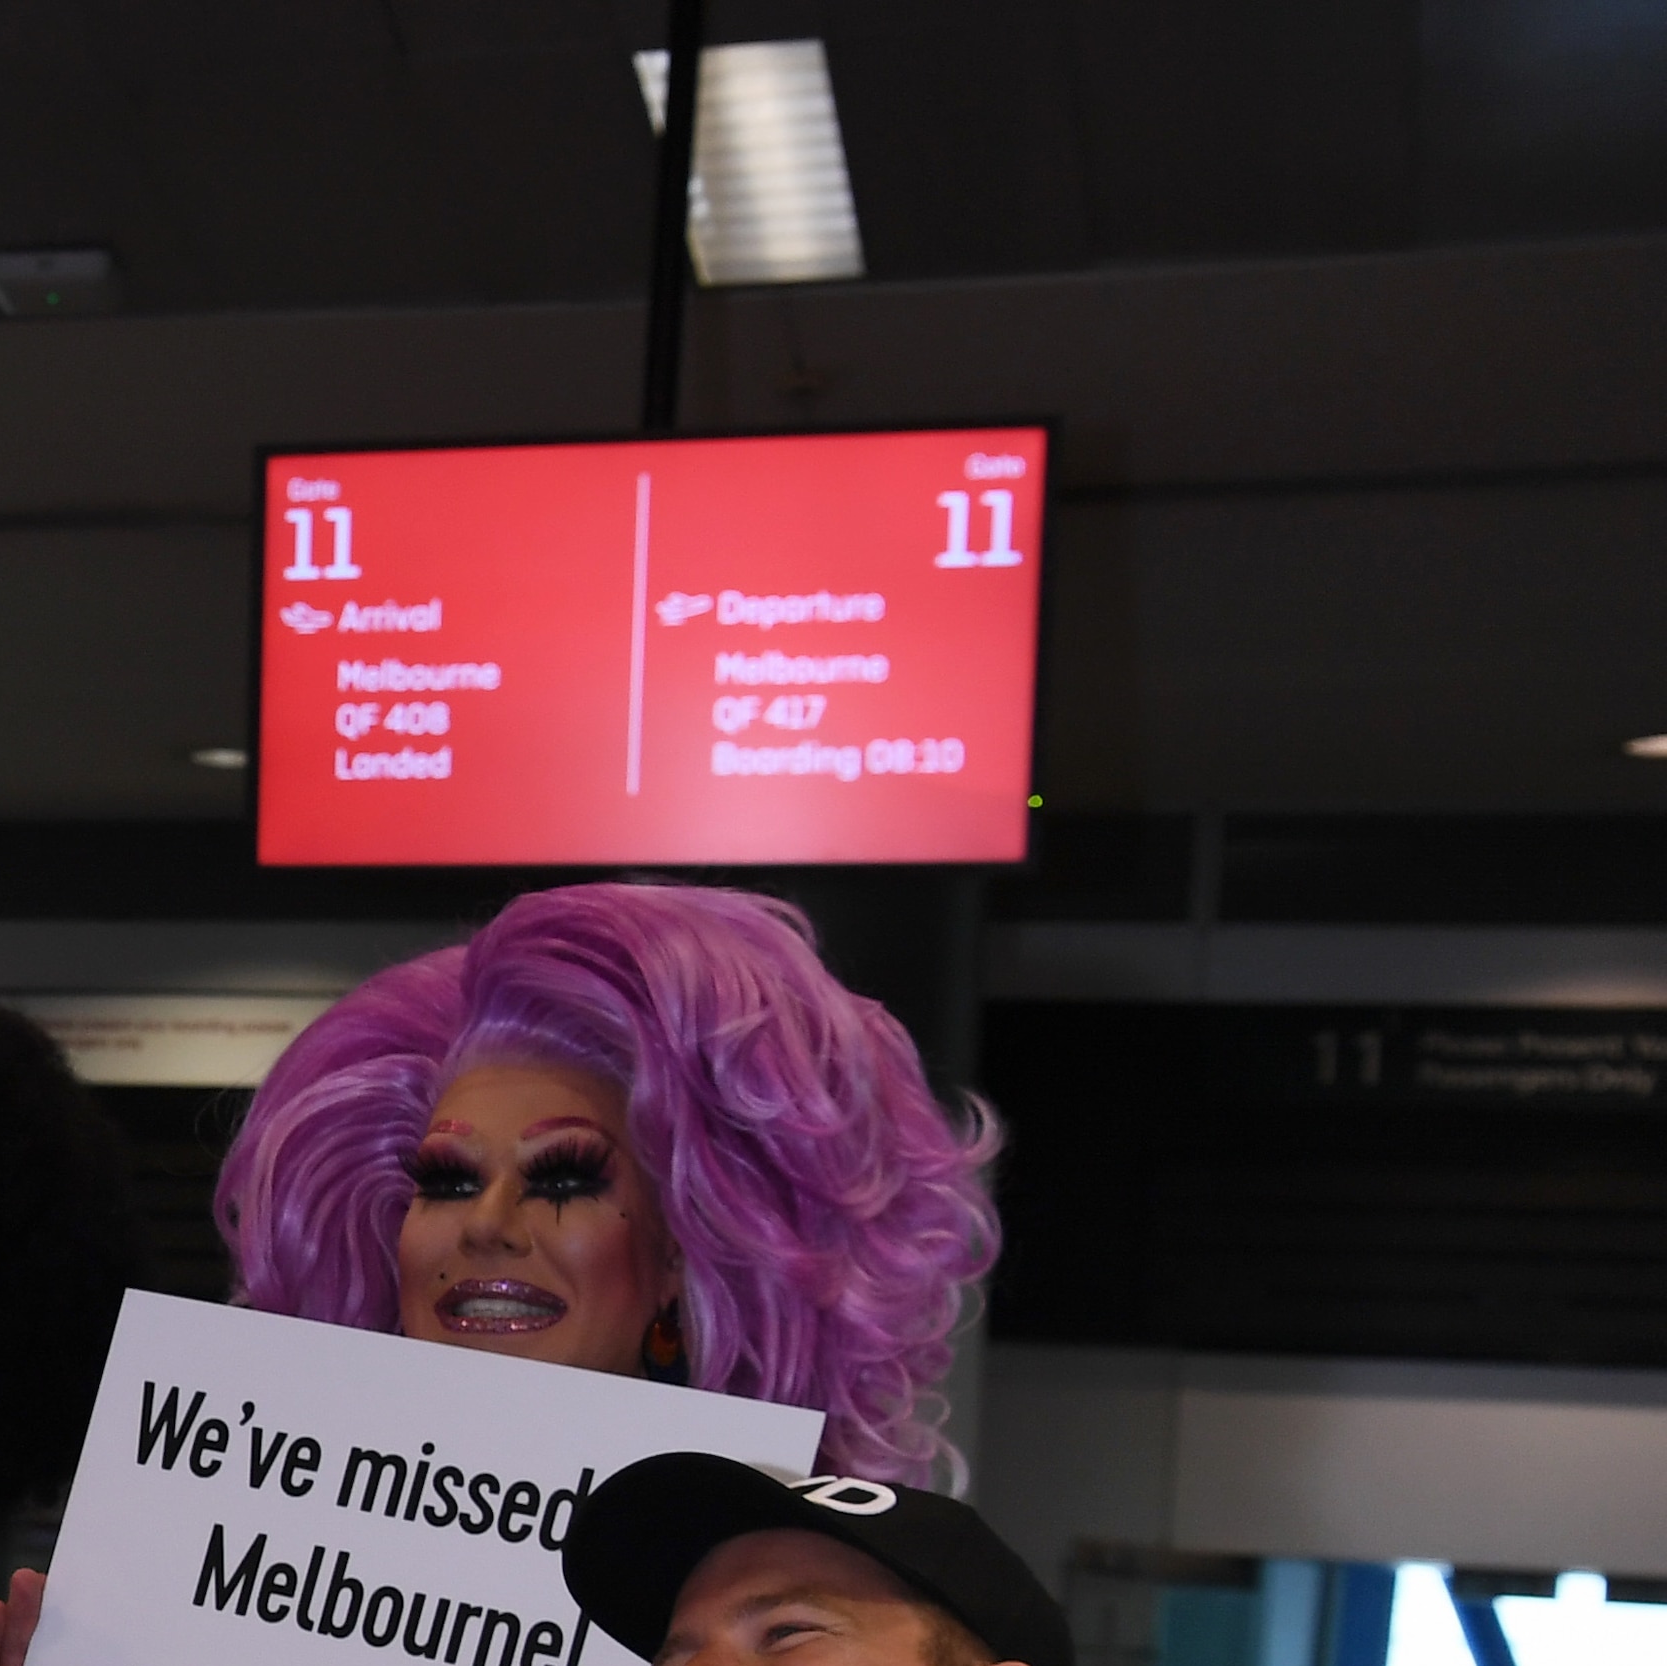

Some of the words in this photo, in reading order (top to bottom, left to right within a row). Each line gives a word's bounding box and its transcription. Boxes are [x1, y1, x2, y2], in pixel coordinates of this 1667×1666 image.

[282, 507, 361, 581] 11
[934, 489, 1022, 568] 11
[337, 600, 441, 634] Arrival
[718, 589, 884, 630] Departure
[337, 659, 501, 691] Melbourne
[715, 652, 889, 685] Melbourne
[335, 704, 379, 738] QF
[713, 697, 760, 732] QF
[764, 695, 826, 728] 417
[335, 748, 452, 780] Landed
[712, 742, 861, 781] Boarding
[136, 1380, 322, 1498] We've
[337, 1442, 594, 1551] missed
